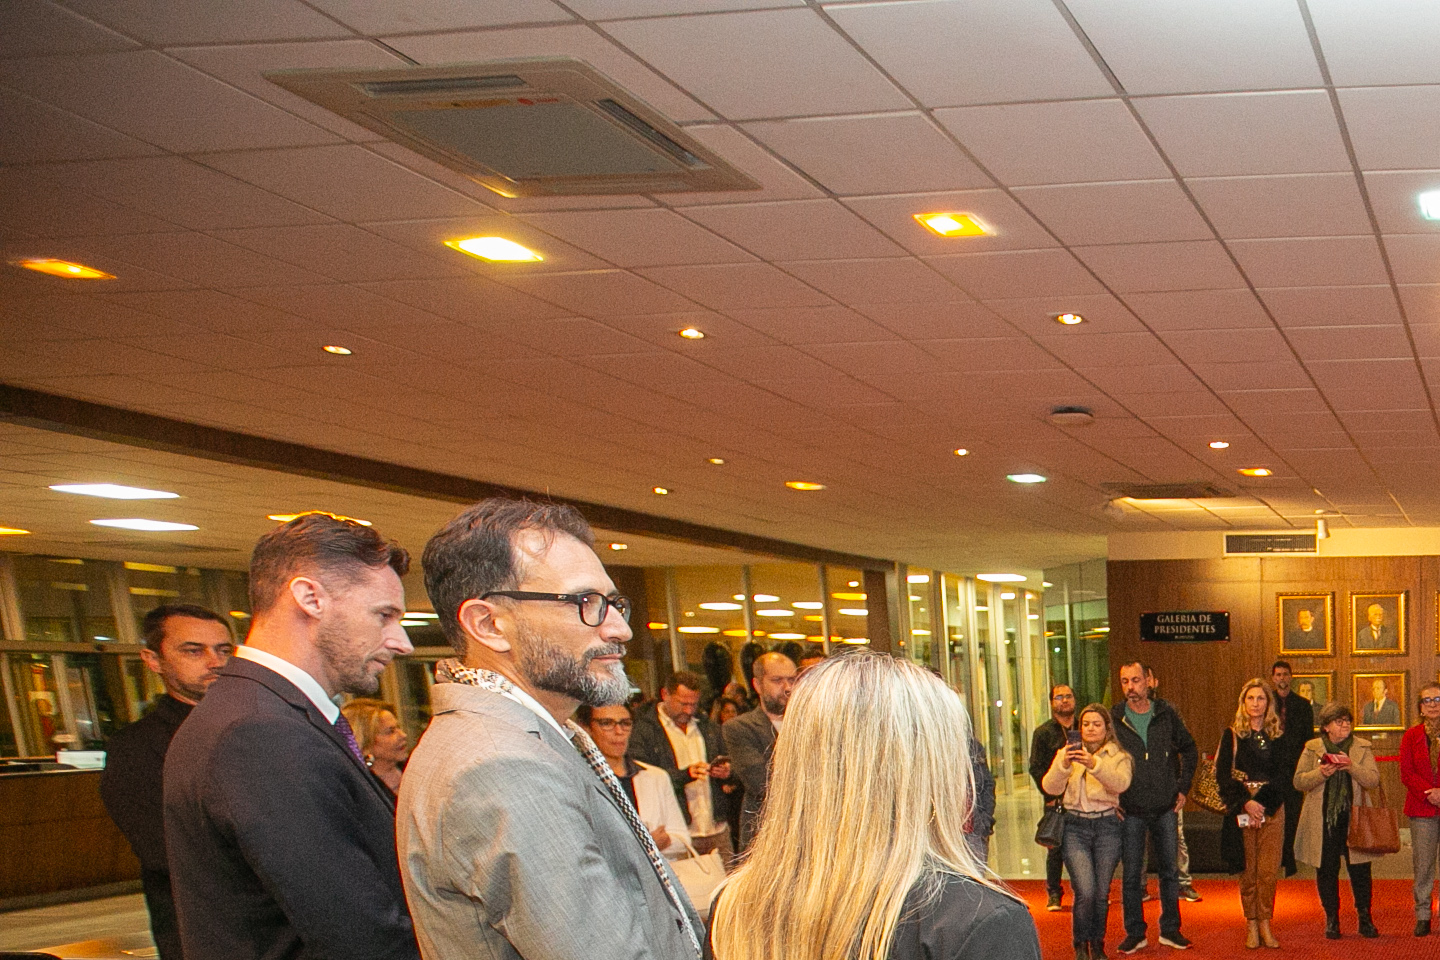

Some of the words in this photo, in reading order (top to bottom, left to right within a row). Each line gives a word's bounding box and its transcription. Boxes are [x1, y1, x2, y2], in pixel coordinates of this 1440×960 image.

[1157, 614, 1197, 623] GALERIA
[1199, 614, 1212, 623] DE
[1154, 625, 1216, 634] PRESIDENTES
